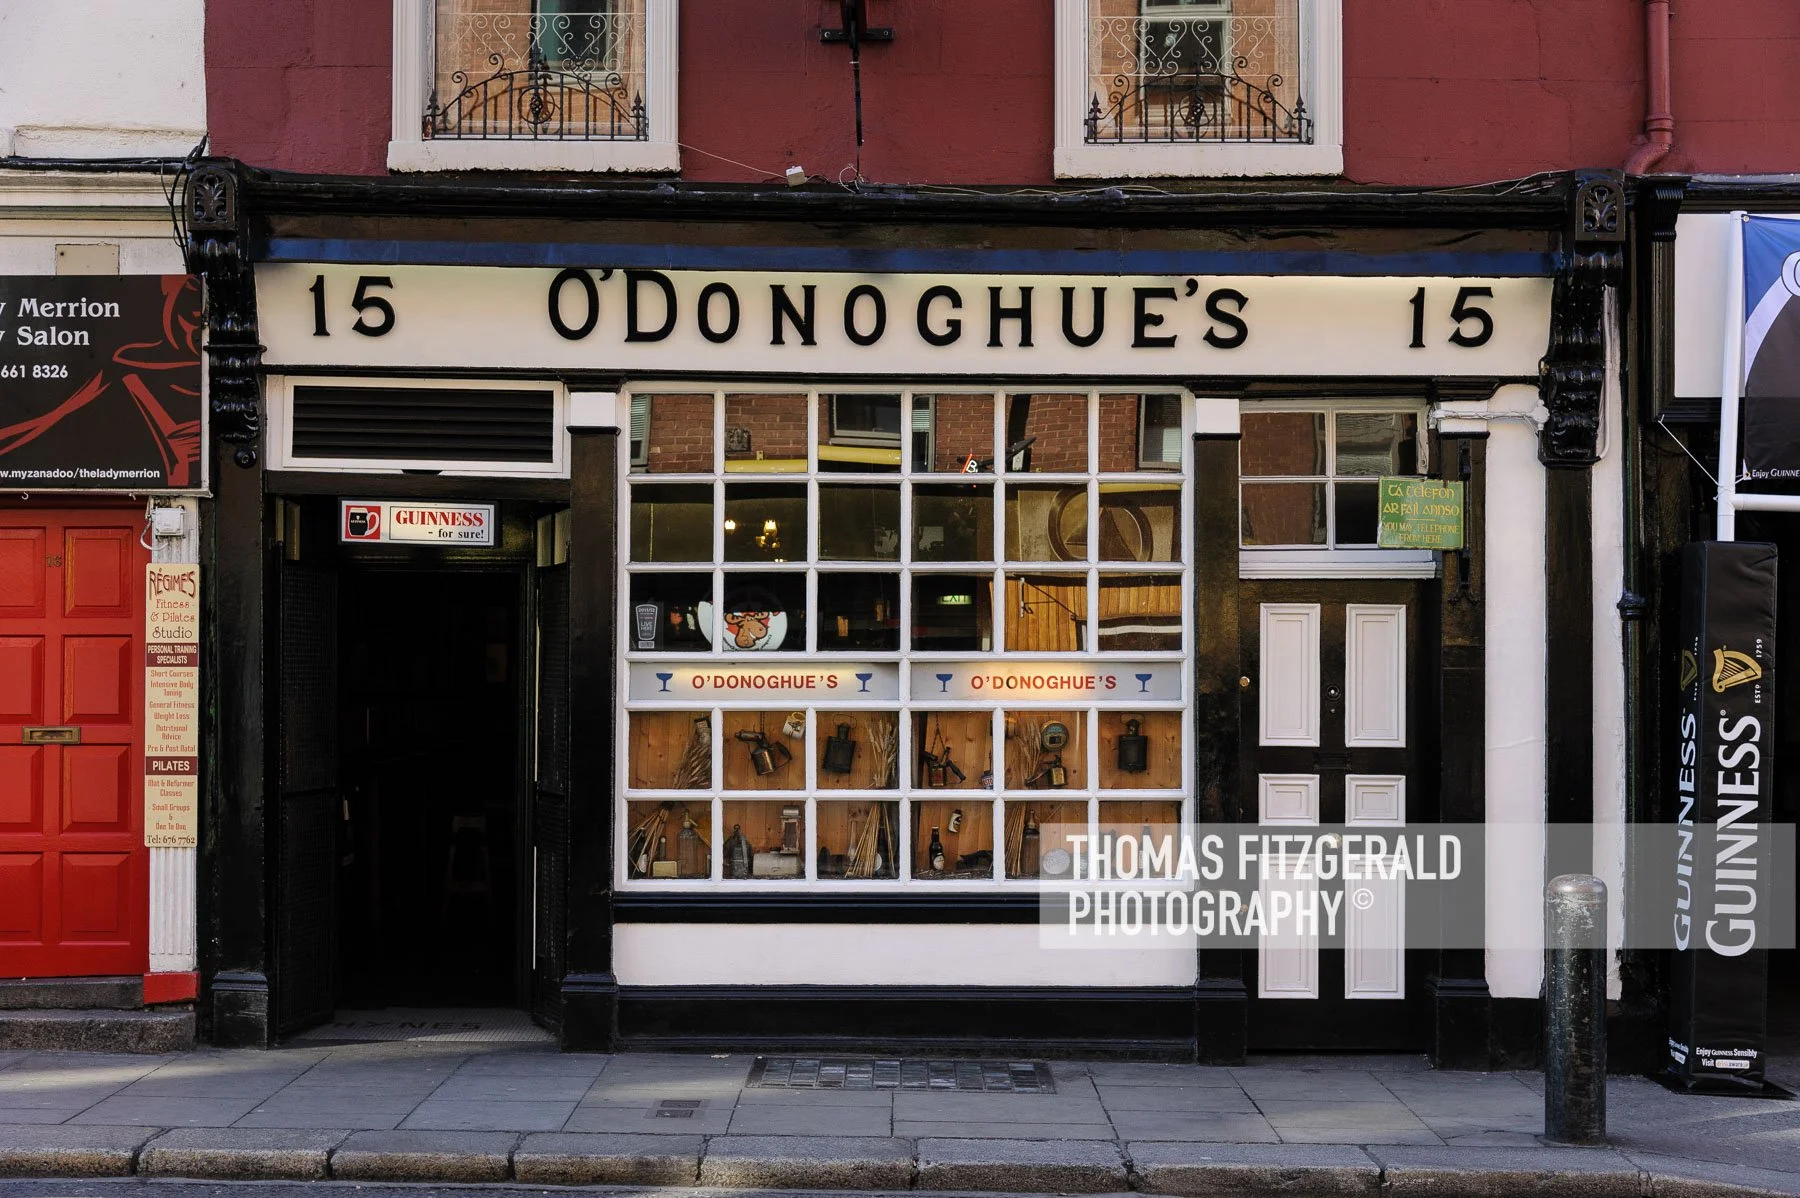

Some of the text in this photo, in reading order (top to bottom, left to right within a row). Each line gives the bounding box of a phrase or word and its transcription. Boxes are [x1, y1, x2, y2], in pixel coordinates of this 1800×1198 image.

[17, 297, 121, 318] Merrion
[308, 267, 1495, 350] 15 O'DONOGHUE'S 15
[16, 326, 91, 346] Salon
[0, 364, 69, 379] 661 8326
[1752, 469, 1770, 479] Enjoy
[395, 510, 484, 528] GUINNESS
[1383, 521, 1398, 532] YOU
[1417, 523, 1460, 534] TELEPHONE
[438, 528, 454, 539] for
[457, 529, 485, 539] sure!
[155, 599, 190, 609] Fitness
[150, 611, 195, 622] & Pilates
[152, 624, 193, 639] Studio
[147, 645, 197, 654] PERSONAL TRAINING
[156, 655, 188, 664] SPECIALISTS
[150, 669, 194, 678] Short Courses
[150, 680, 178, 688] Intensive
[691, 674, 839, 690] O'DONOGHUE'S
[970, 675, 1118, 690] O'DONOGHUE'S
[149, 701, 195, 709] General Fitness
[153, 712, 190, 721] Weight Loss
[155, 724, 188, 732] Nutritional
[161, 732, 182, 741] Advice
[147, 744, 159, 752] Pre
[152, 760, 190, 771] PILATES
[147, 779, 160, 787] Mat
[166, 779, 194, 787] Reformer
[160, 789, 183, 797] Classes
[152, 803, 191, 813] Small Groups
[1673, 710, 1696, 952] GUINNESS
[146, 834, 196, 846] Tel: 676 7762
[1695, 1046, 1711, 1057] Enjoy
[1733, 1048, 1758, 1059] Sensibly
[1701, 1058, 1715, 1067] Visit
